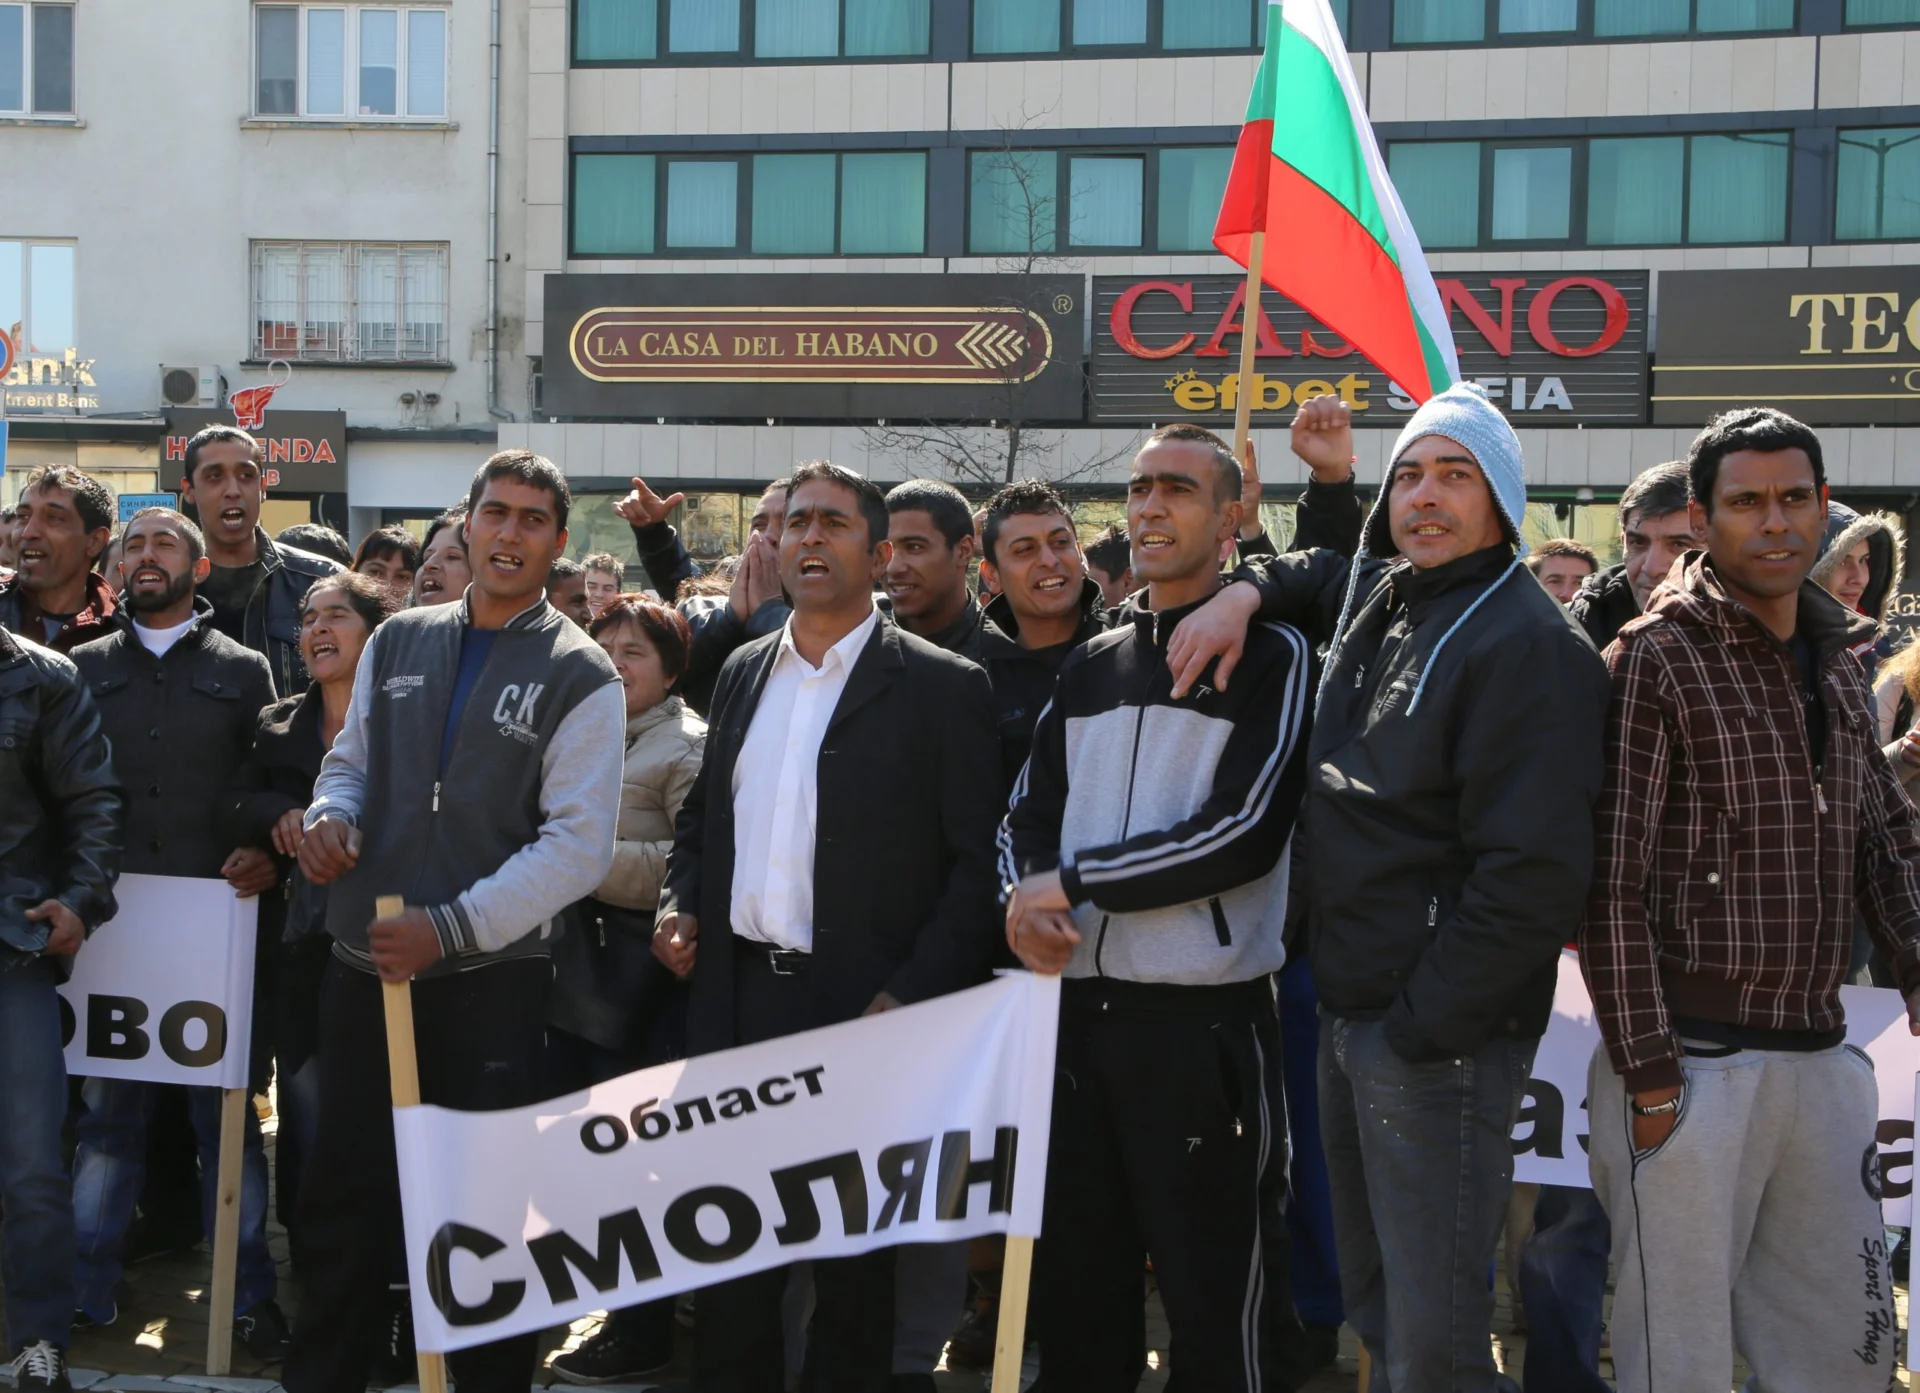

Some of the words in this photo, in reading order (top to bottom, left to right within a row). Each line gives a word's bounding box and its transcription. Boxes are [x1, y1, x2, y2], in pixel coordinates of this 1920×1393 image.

[1110, 277, 1629, 358] CANO
[596, 337, 630, 356] LA
[639, 332, 722, 357] CASA
[733, 336, 785, 356] DEL
[795, 332, 938, 357] HABANO
[57, 392, 98, 408] Bank
[1173, 373, 1370, 411] efbet
[1387, 376, 1574, 411] SFIA
[120, 500, 146, 508] СИНЯ
[493, 682, 545, 726] CK
[580, 1064, 825, 1155] Област
